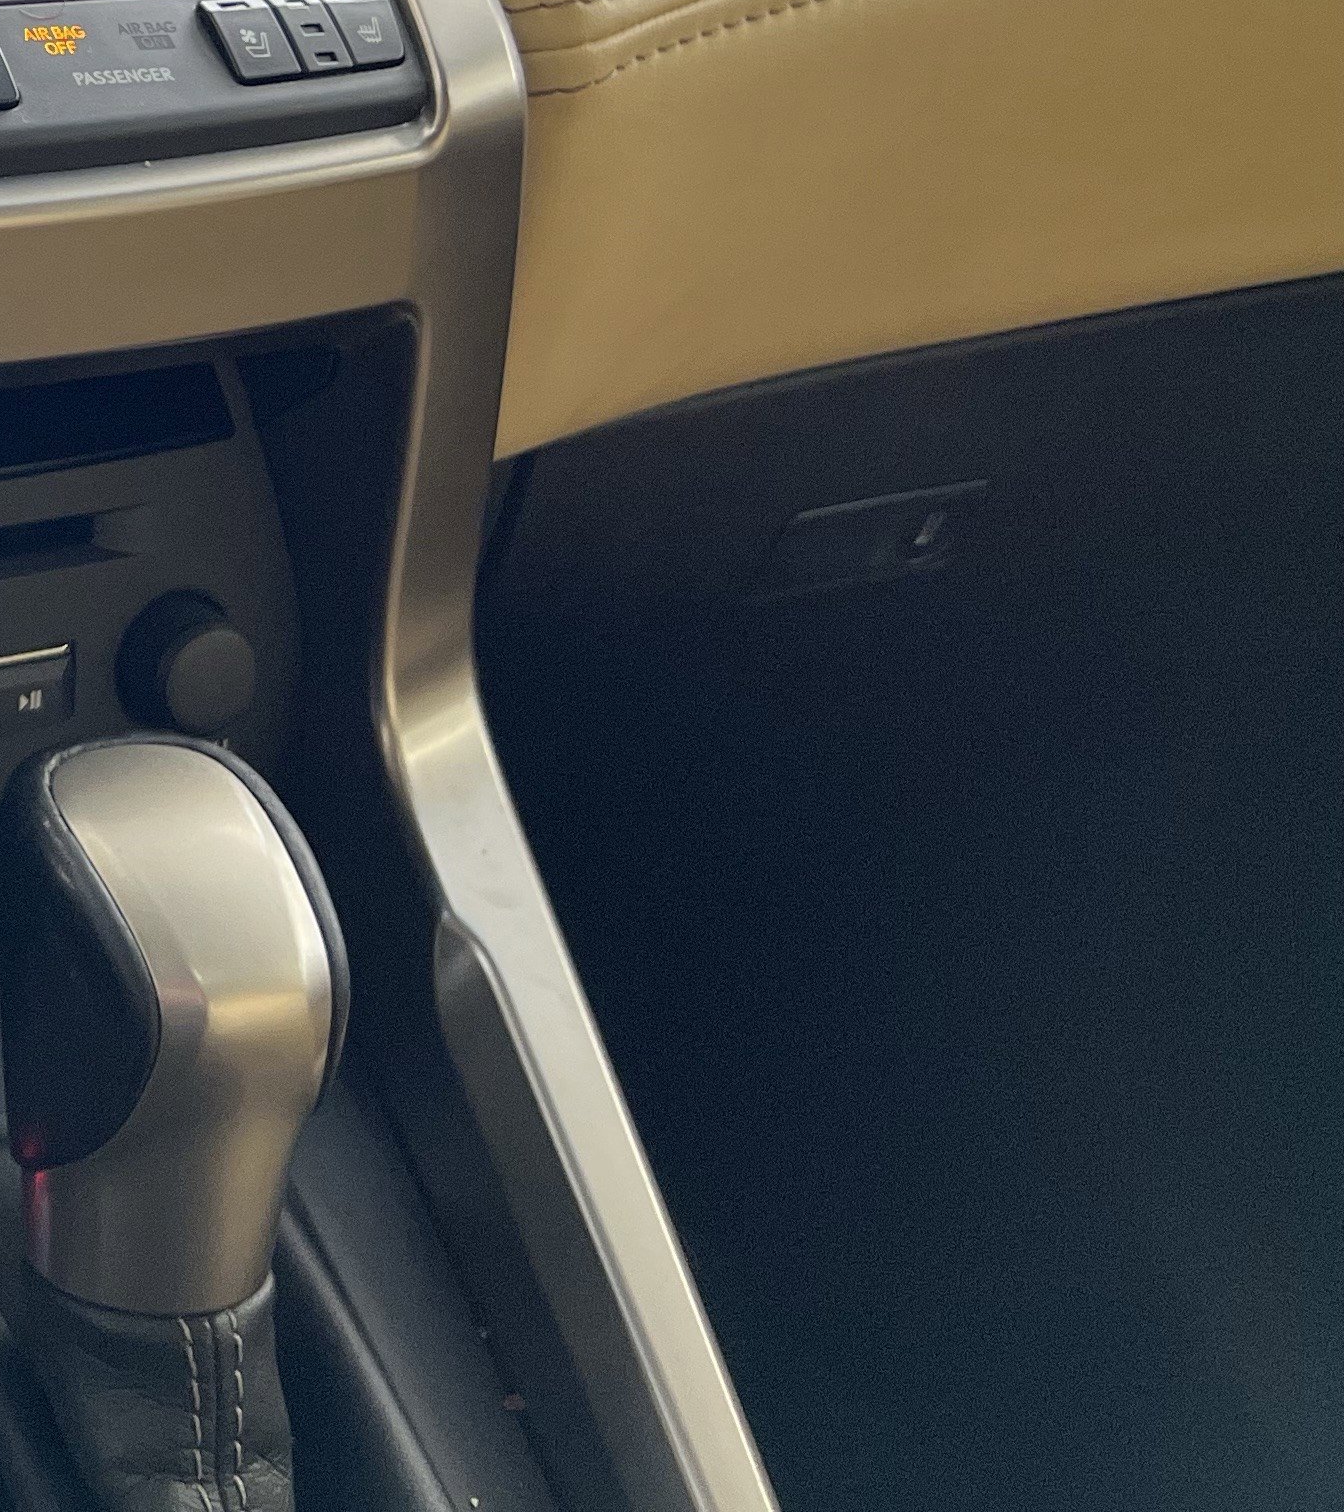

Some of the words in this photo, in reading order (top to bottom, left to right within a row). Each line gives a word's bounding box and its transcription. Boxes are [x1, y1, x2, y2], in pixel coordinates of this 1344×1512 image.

[23, 26, 49, 42] AIR
[51, 23, 86, 40] BAG
[116, 21, 146, 36] AIR
[147, 20, 177, 34] BAG
[43, 40, 77, 56] OFF
[72, 66, 176, 87] PASSENGER
